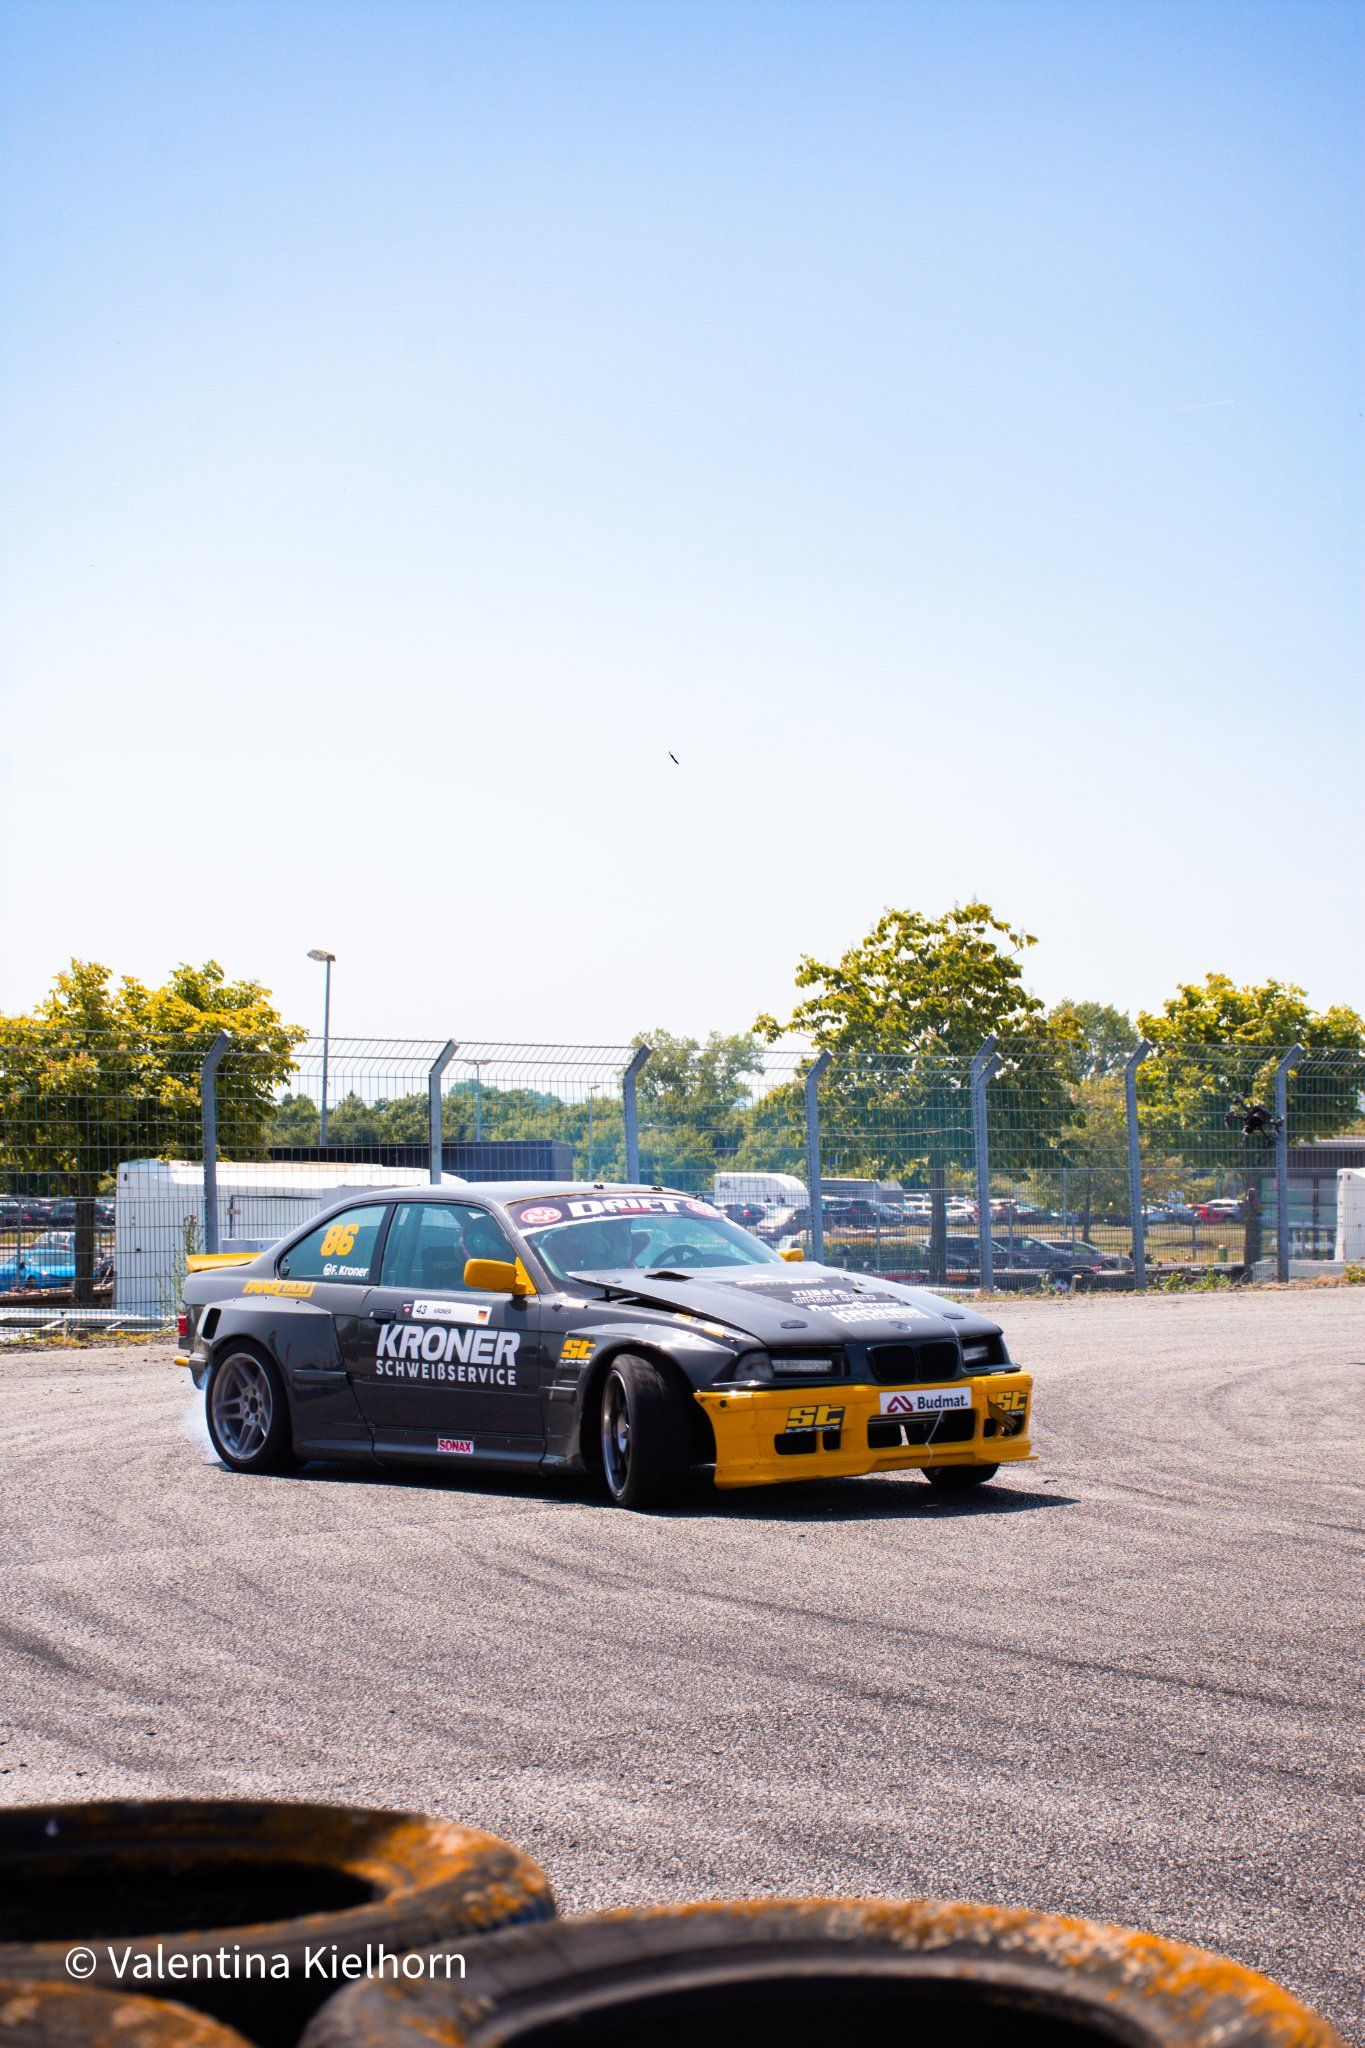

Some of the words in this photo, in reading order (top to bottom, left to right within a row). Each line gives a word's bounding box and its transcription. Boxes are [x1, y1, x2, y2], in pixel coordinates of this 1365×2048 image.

[320, 1223, 359, 1256] 86
[338, 1265, 370, 1277] Kroner
[416, 1304, 428, 1315] 43
[376, 1324, 520, 1366] KRONER
[439, 1440, 471, 1452] SONAX
